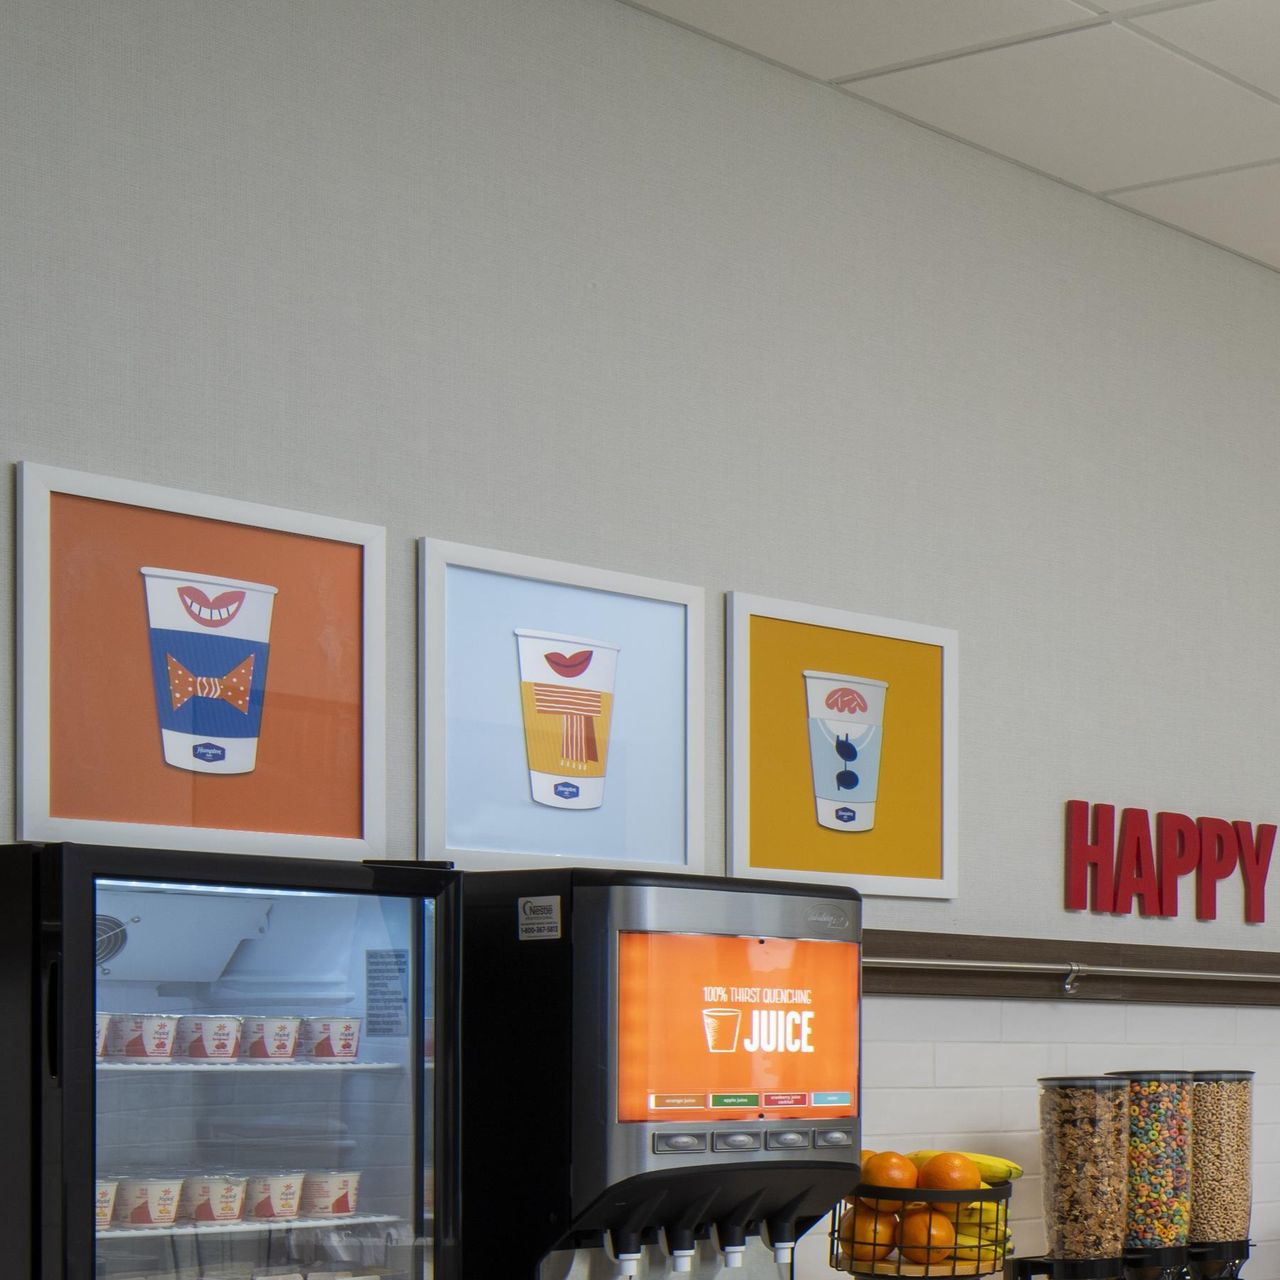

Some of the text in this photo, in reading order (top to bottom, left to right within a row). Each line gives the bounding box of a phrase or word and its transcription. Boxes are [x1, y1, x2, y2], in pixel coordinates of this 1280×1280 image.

[1063, 799, 1277, 924] HAPPY
[703, 986, 812, 1004] 100% THIRST QUENCHING
[743, 1010, 815, 1053] JUICE
